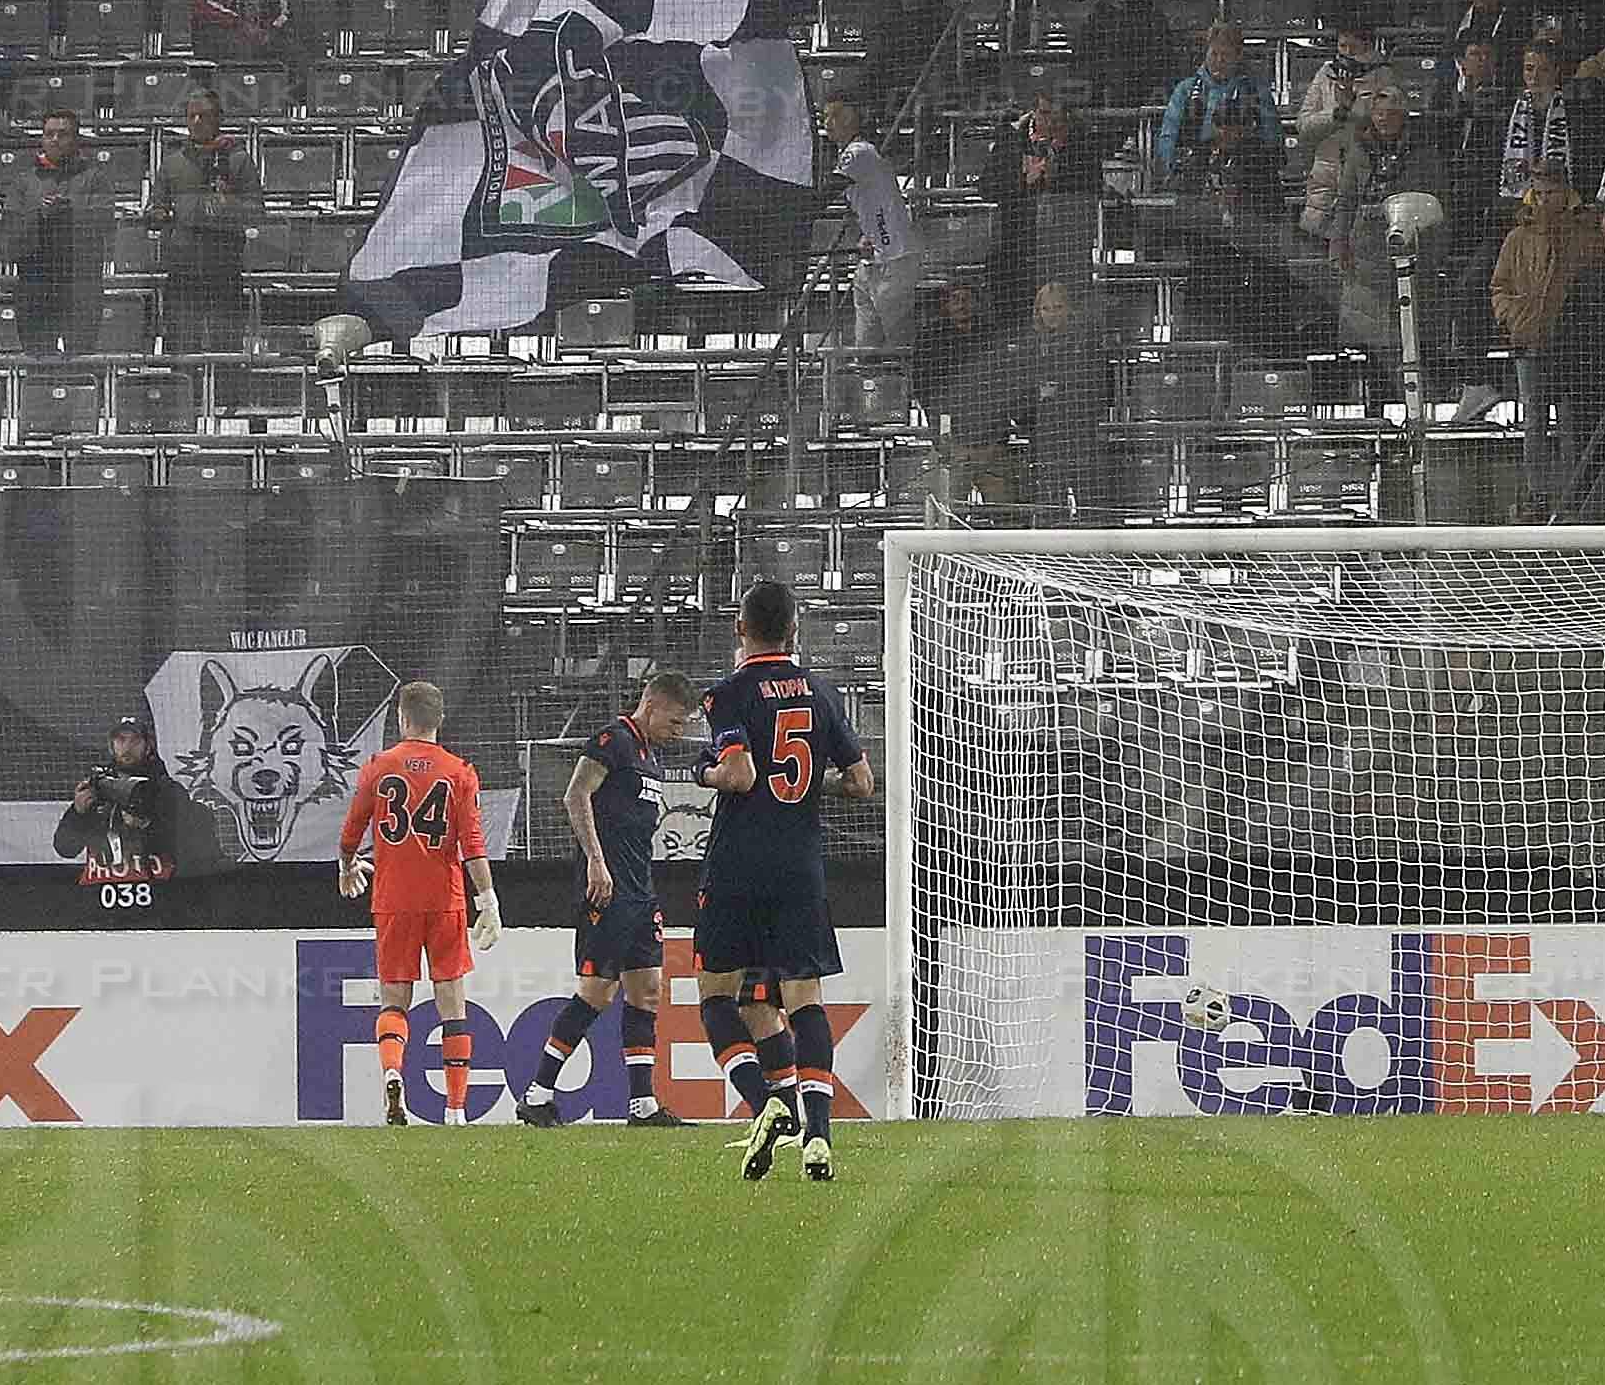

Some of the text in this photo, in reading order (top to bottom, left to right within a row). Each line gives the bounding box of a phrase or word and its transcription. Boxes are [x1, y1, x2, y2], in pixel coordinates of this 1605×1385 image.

[767, 707, 813, 804] 5
[378, 774, 452, 850] 34
[100, 883, 153, 909] 038
